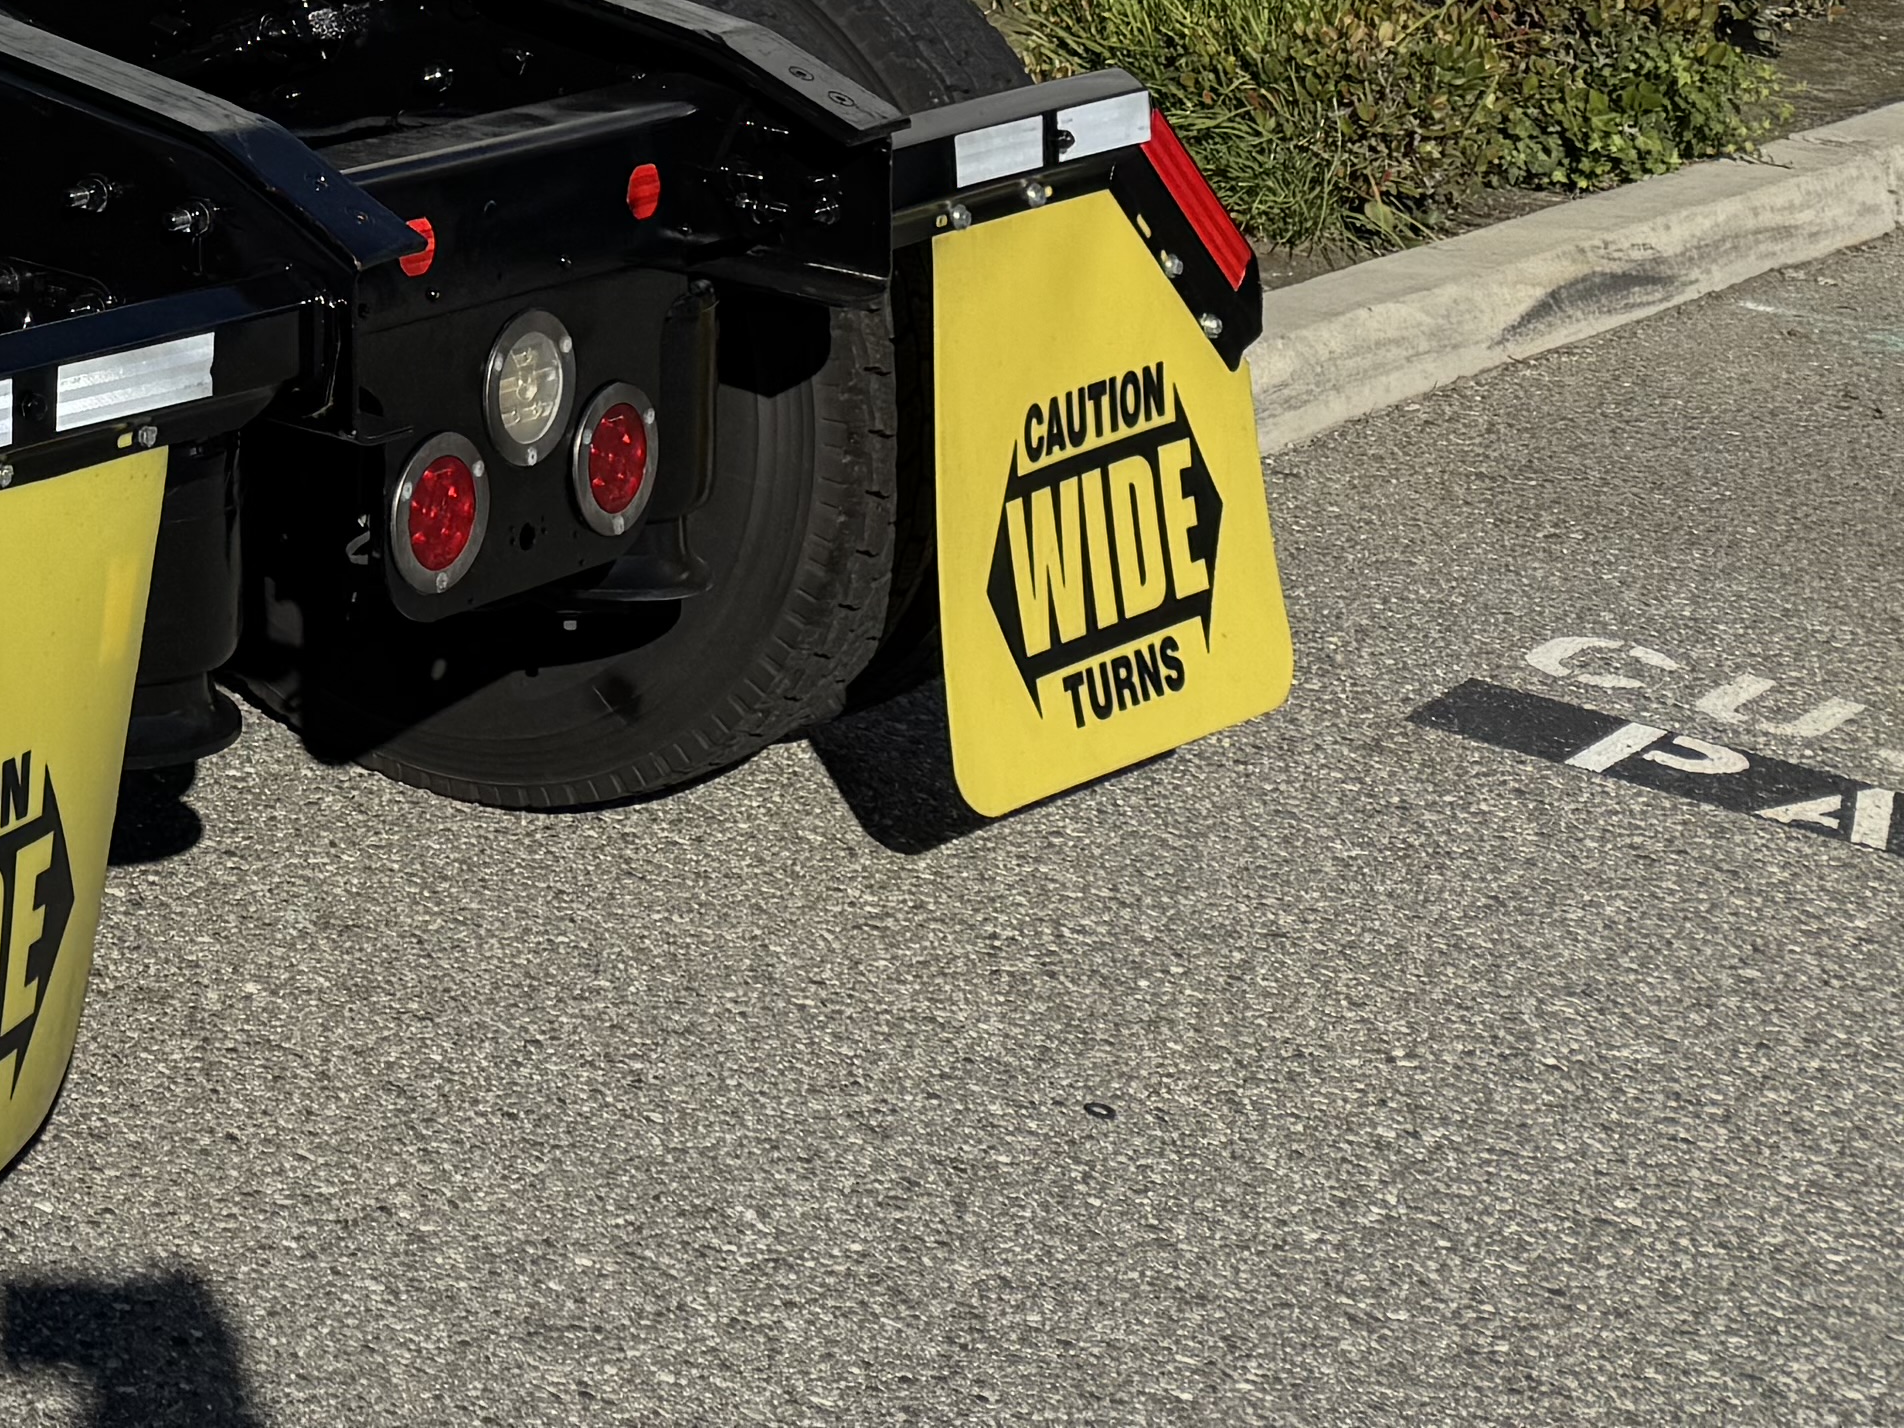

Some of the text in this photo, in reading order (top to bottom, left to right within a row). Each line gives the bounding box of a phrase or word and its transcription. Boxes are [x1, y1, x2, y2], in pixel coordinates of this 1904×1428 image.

[1022, 359, 1166, 456] CAUTION
[1005, 436, 1211, 659] WIDE
[1062, 634, 1186, 729] TURNS
[1524, 636, 1904, 770] CU
